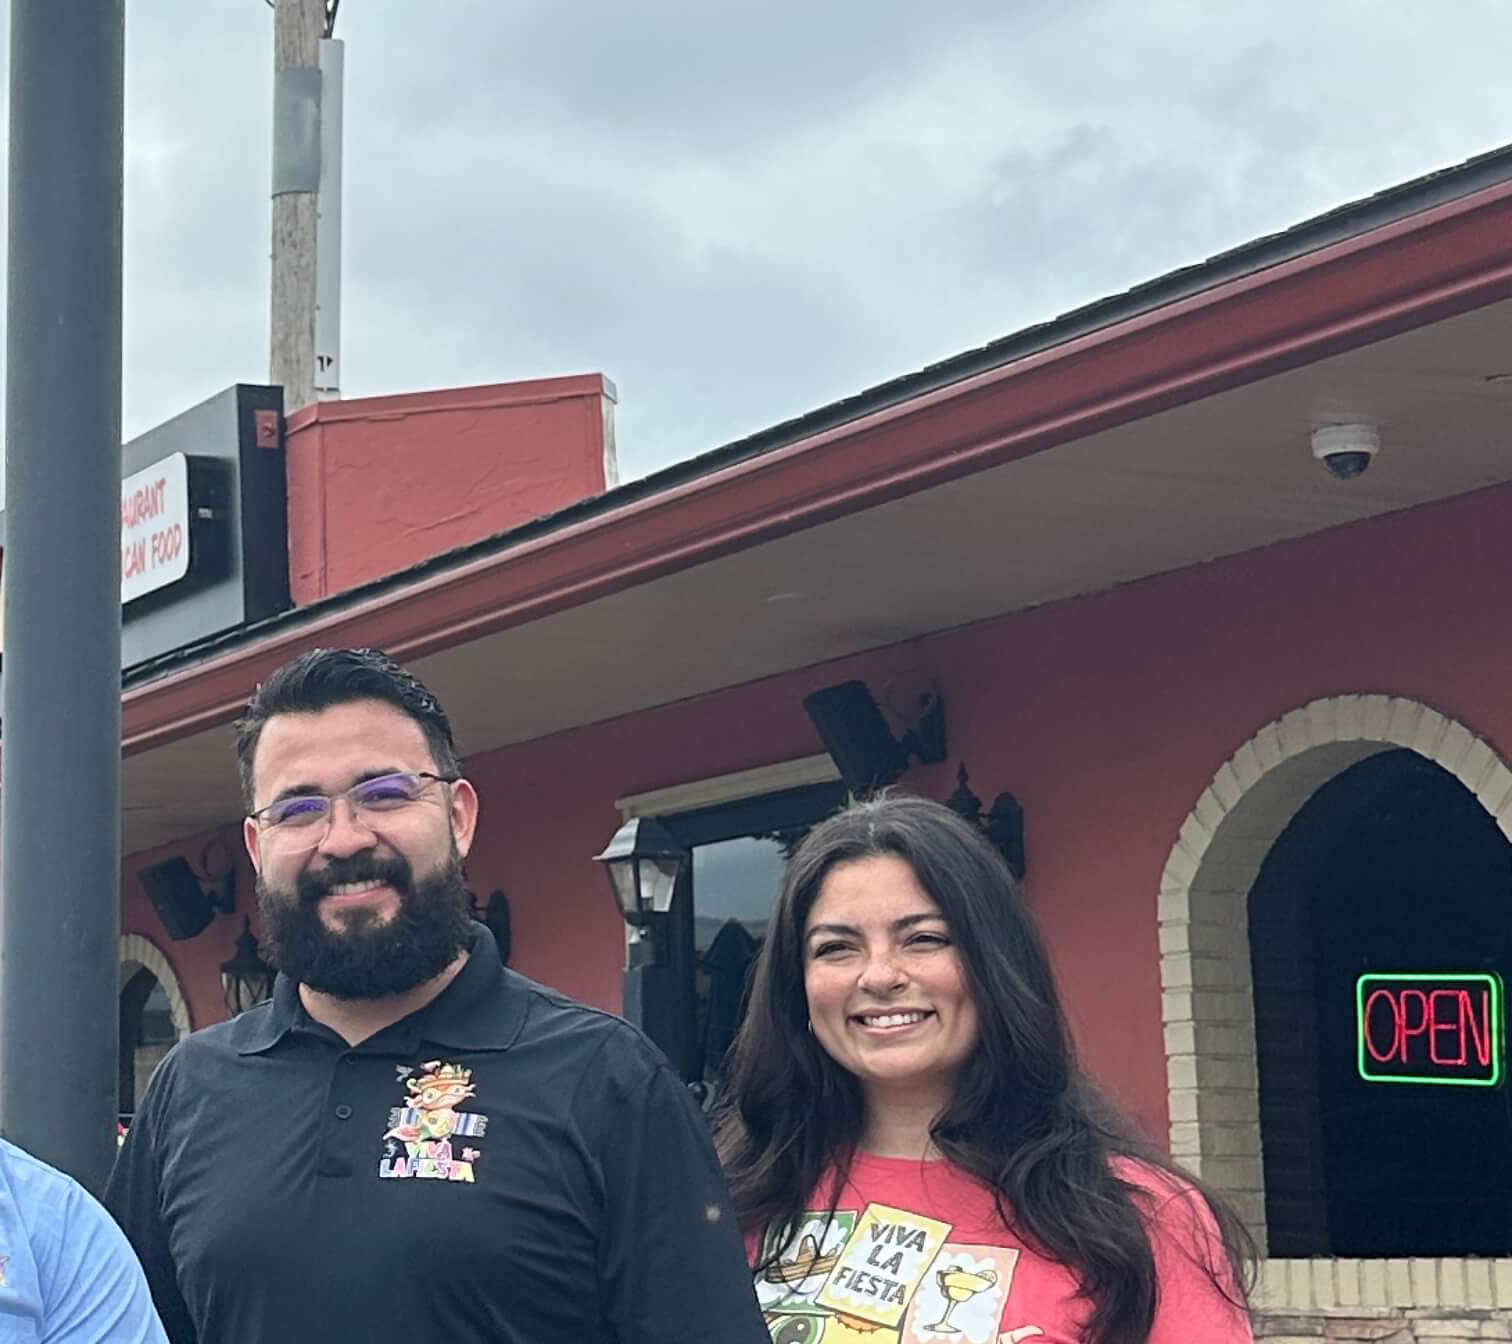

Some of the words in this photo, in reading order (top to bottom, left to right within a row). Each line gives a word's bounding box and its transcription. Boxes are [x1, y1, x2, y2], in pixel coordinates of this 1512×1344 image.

[124, 537, 146, 578] CAN
[152, 523, 182, 568] FOOD
[1364, 989, 1489, 1066] OPEN
[405, 1140, 452, 1160] VIVA
[870, 1222, 927, 1253] VIVA
[866, 1244, 904, 1275] LA
[832, 1266, 907, 1305] FIESTA
